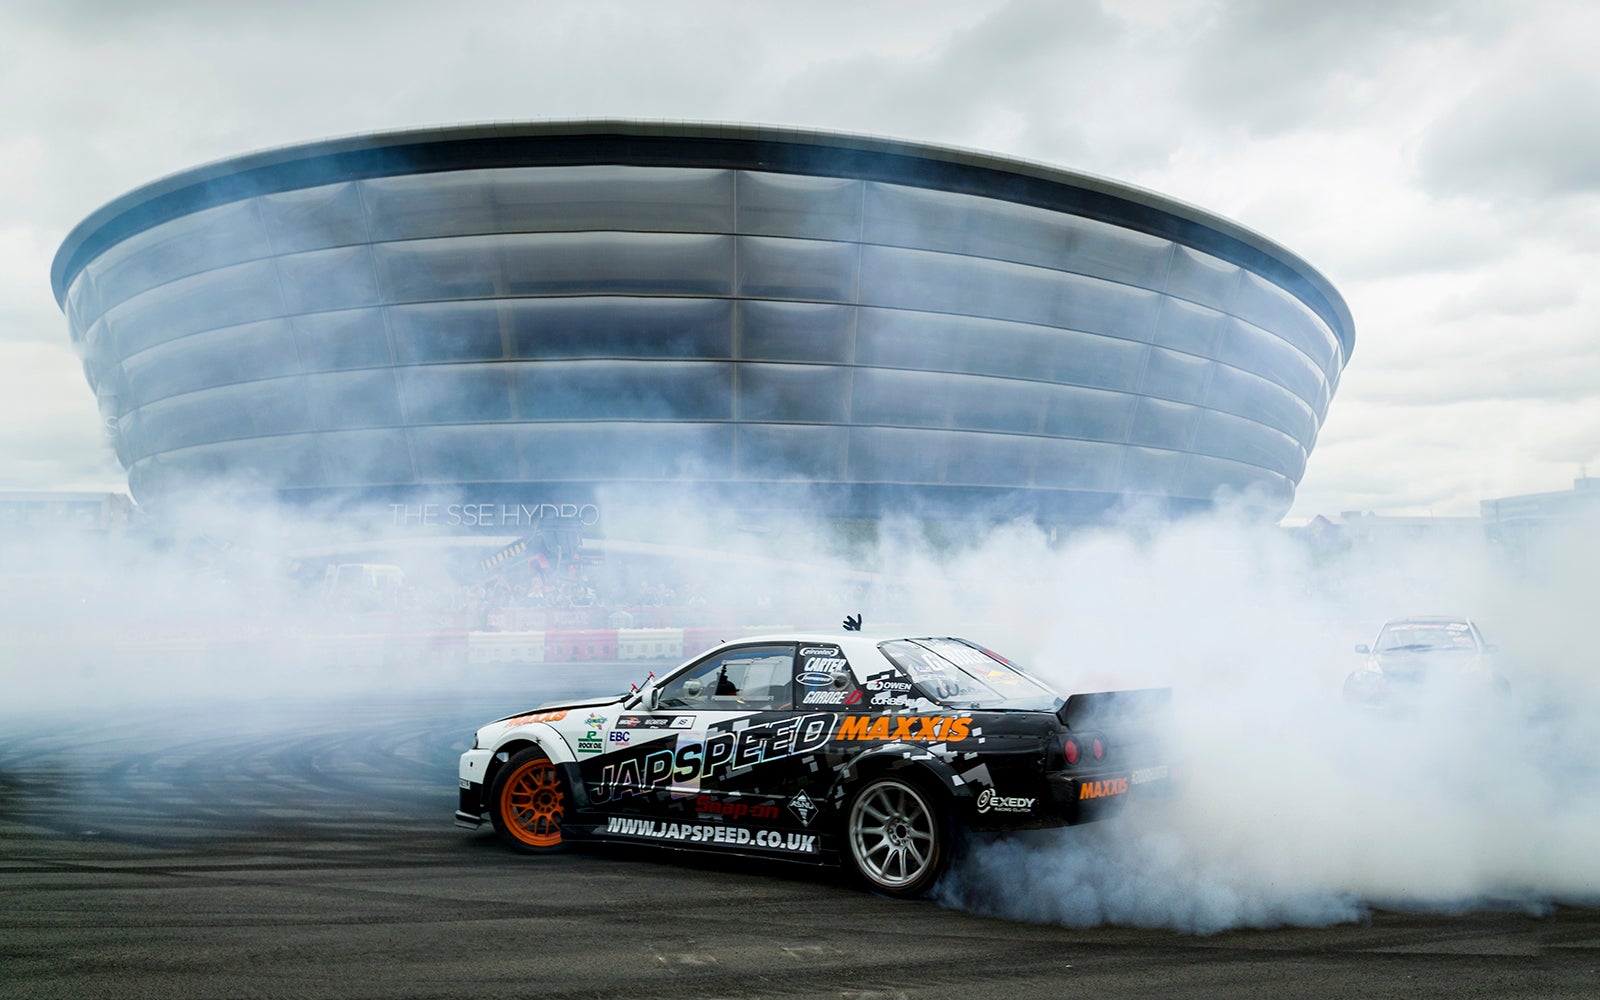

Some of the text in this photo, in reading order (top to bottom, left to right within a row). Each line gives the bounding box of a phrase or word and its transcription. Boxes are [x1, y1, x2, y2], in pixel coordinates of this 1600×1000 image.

[390, 503, 600, 526] THE SSE HYDRO
[804, 657, 847, 673] CARTER
[883, 681, 912, 691] OWEN
[609, 731, 630, 742] EBC
[836, 715, 973, 743] MAXXIS
[590, 712, 839, 805] JAPSPEED
[1079, 777, 1128, 800] MAXXIS
[695, 795, 780, 820] Snap-on
[990, 797, 1036, 808] EXEDY
[607, 816, 817, 852] WWW.JAPSPEED.CO.UK
